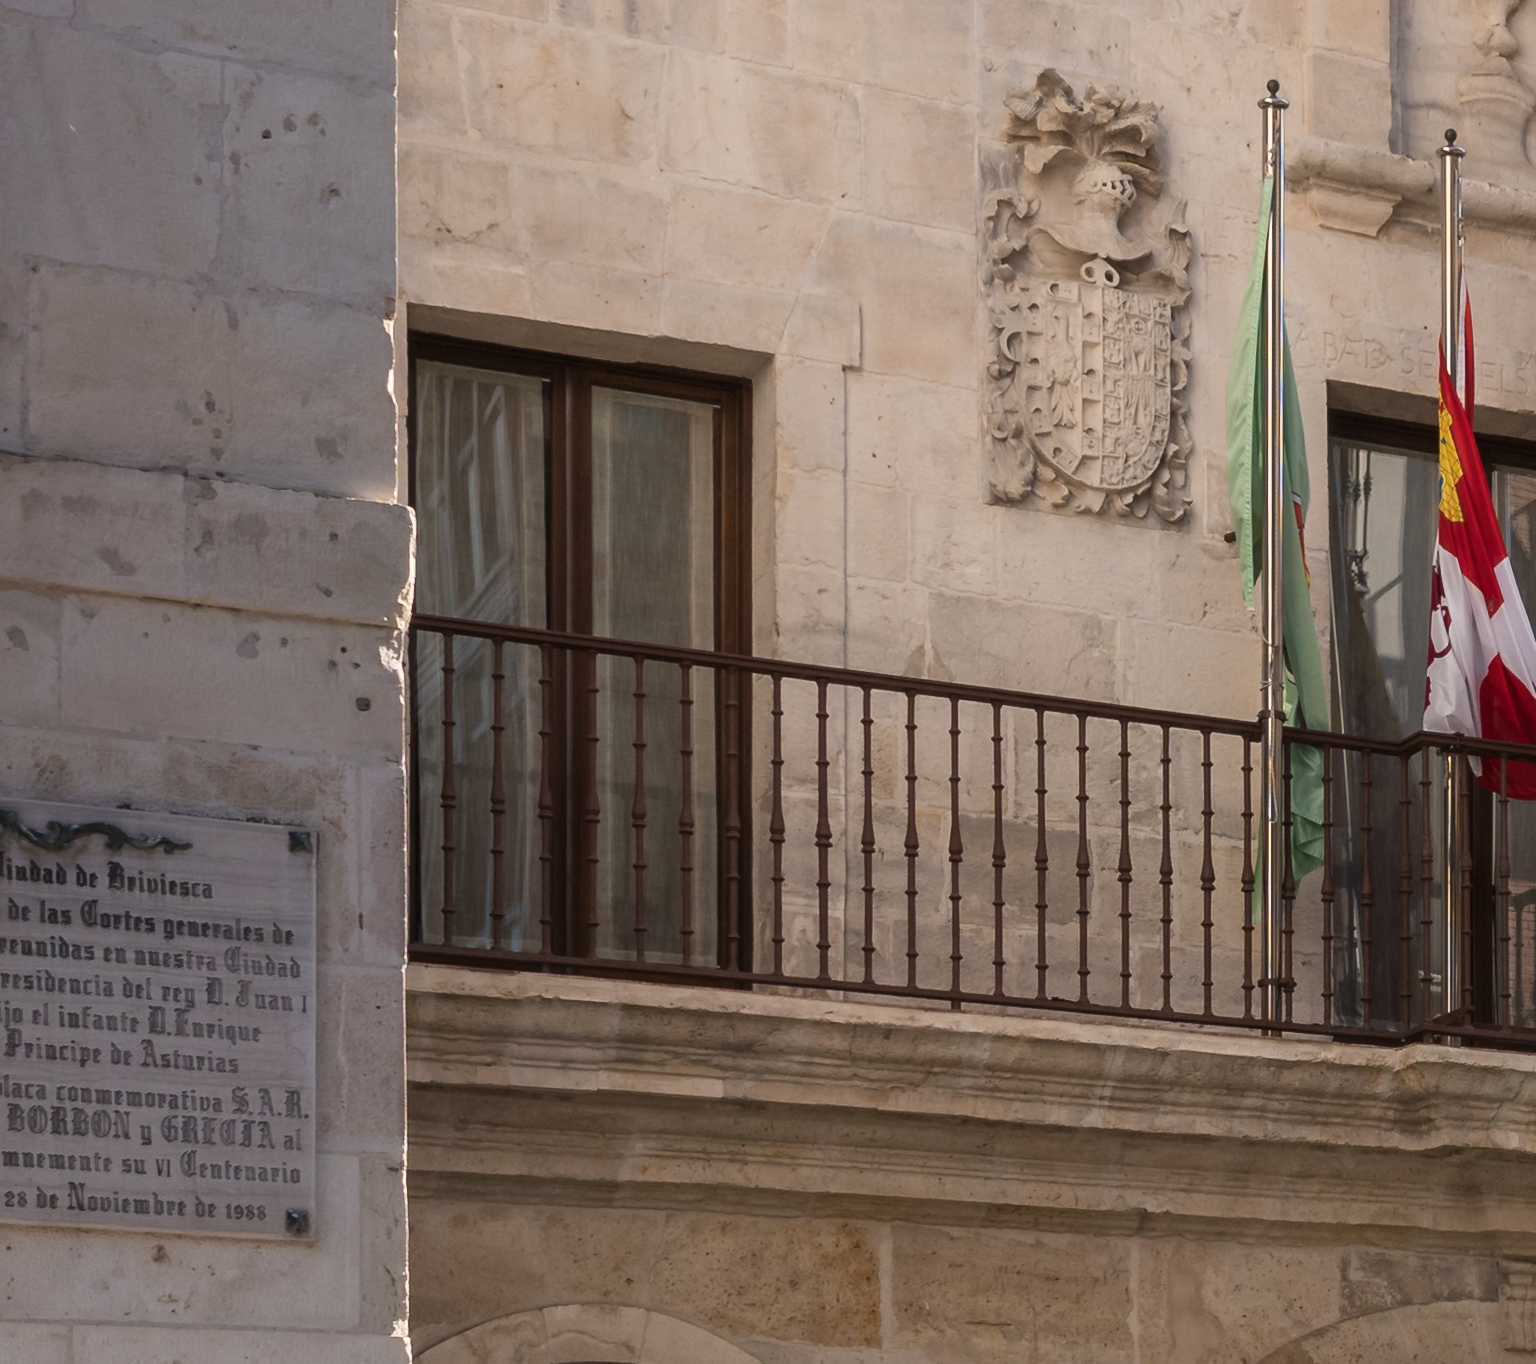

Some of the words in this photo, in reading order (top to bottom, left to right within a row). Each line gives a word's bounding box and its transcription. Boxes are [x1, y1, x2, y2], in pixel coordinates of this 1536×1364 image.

[0, 851, 68, 886] iudad
[76, 864, 99, 888] de
[107, 860, 213, 899] Briviesca
[8, 897, 31, 922] de
[39, 899, 72, 925] las
[80, 899, 156, 933] Cortes
[163, 918, 265, 942] generales
[272, 922, 295, 946] de
[103, 946, 128, 964] en
[134, 949, 218, 972] nuestra
[224, 946, 301, 979] Ciudad
[122, 975, 153, 1001] del
[161, 985, 196, 1008] rey
[0, 1000, 23, 1027] jo
[32, 1003, 49, 1026] el
[58, 1005, 140, 1033] infante
[3, 1027, 102, 1067] Principe
[110, 1041, 133, 1066] de
[140, 1038, 239, 1074] Asturias
[0, 1074, 48, 1100] laca
[55, 1085, 223, 1113] conmemorativa
[7, 1102, 131, 1140] BORBON
[140, 1124, 153, 1146] y
[283, 1128, 302, 1151] al
[121, 1158, 147, 1175] su
[155, 1159, 171, 1177] VI
[179, 1149, 301, 1185] Centenario
[3, 1190, 28, 1208] 28
[36, 1186, 59, 1209] de
[67, 1181, 187, 1217] Noviembre
[195, 1195, 217, 1219] de
[225, 1203, 267, 1221] 1988
